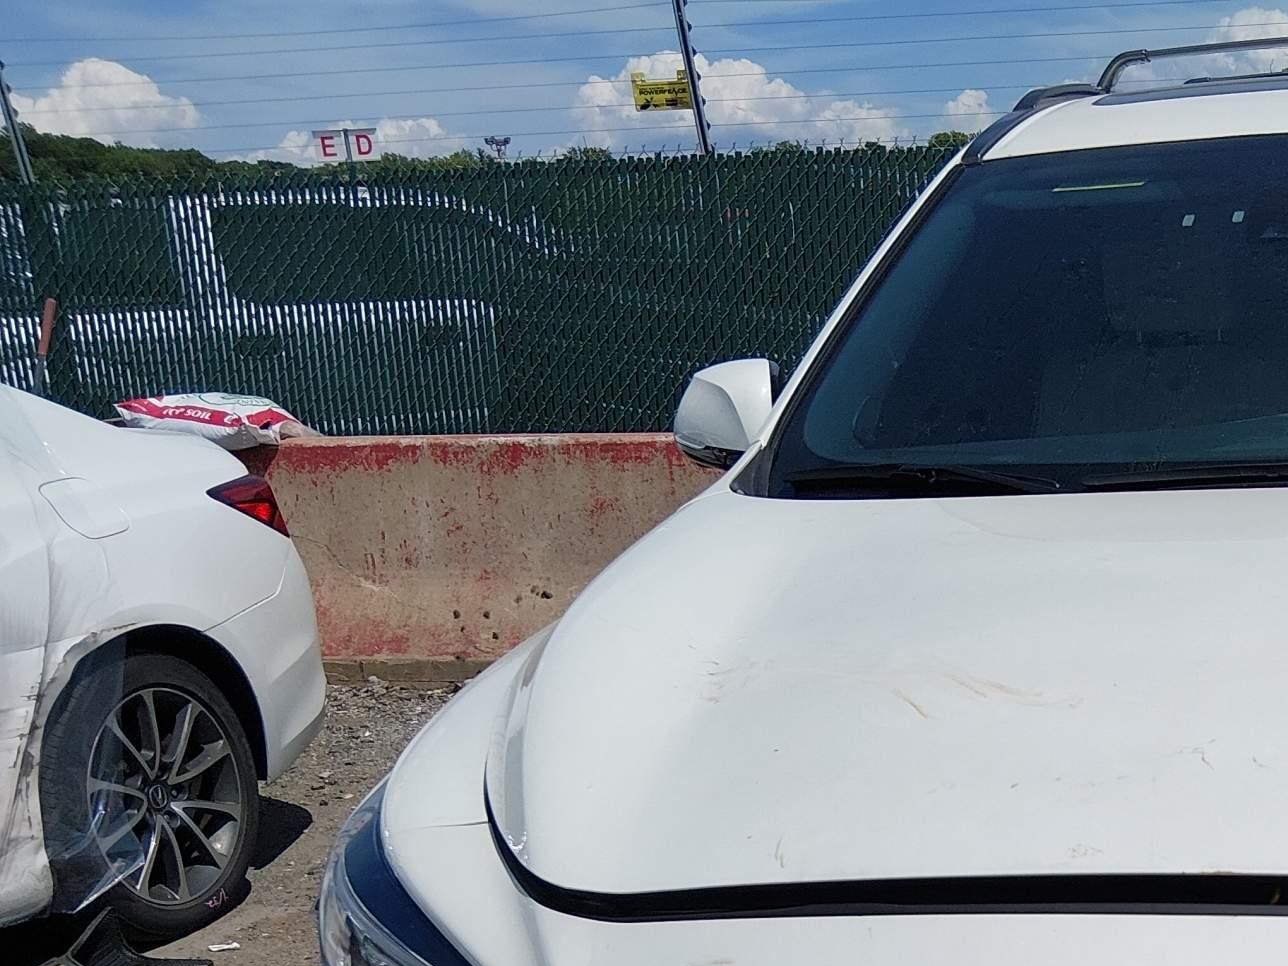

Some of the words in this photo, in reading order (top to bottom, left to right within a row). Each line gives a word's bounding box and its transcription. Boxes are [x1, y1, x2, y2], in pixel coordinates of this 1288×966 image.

[320, 136, 337, 157] E
[355, 134, 372, 155] D
[184, 408, 212, 420] SOIL
